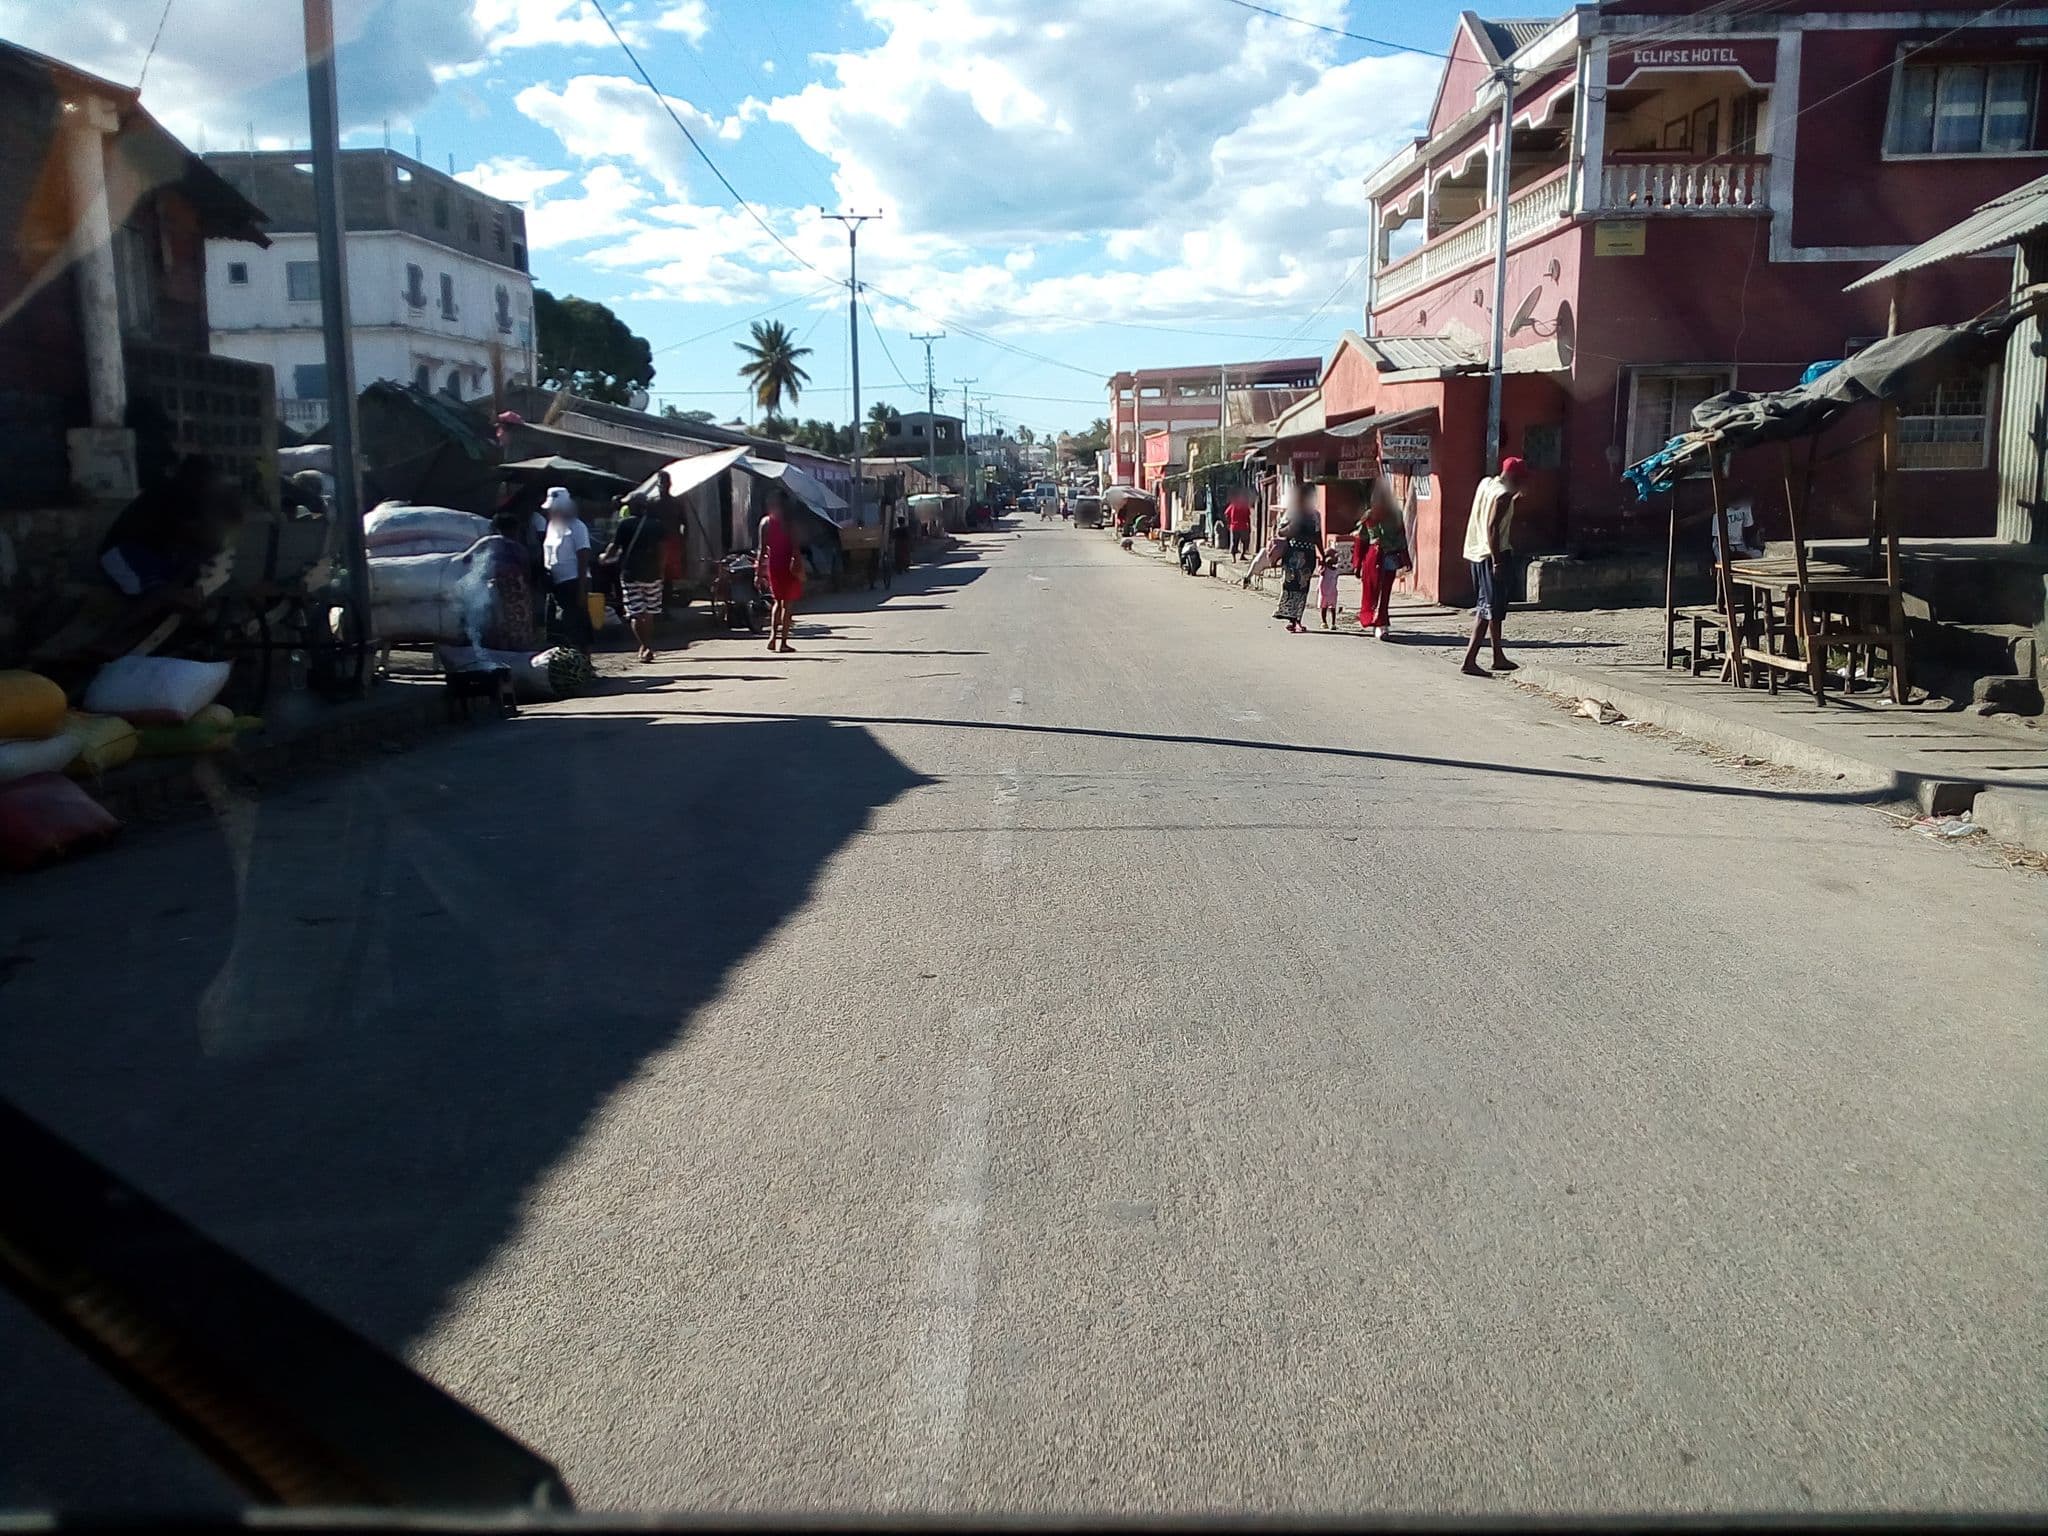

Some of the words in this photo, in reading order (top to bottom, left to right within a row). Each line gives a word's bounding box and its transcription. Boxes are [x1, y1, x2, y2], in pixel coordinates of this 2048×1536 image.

[1633, 49, 1689, 63] ECLIPSE
[1691, 48, 1738, 62] HOTEL
[1383, 436, 1428, 447] COIFFEUR
